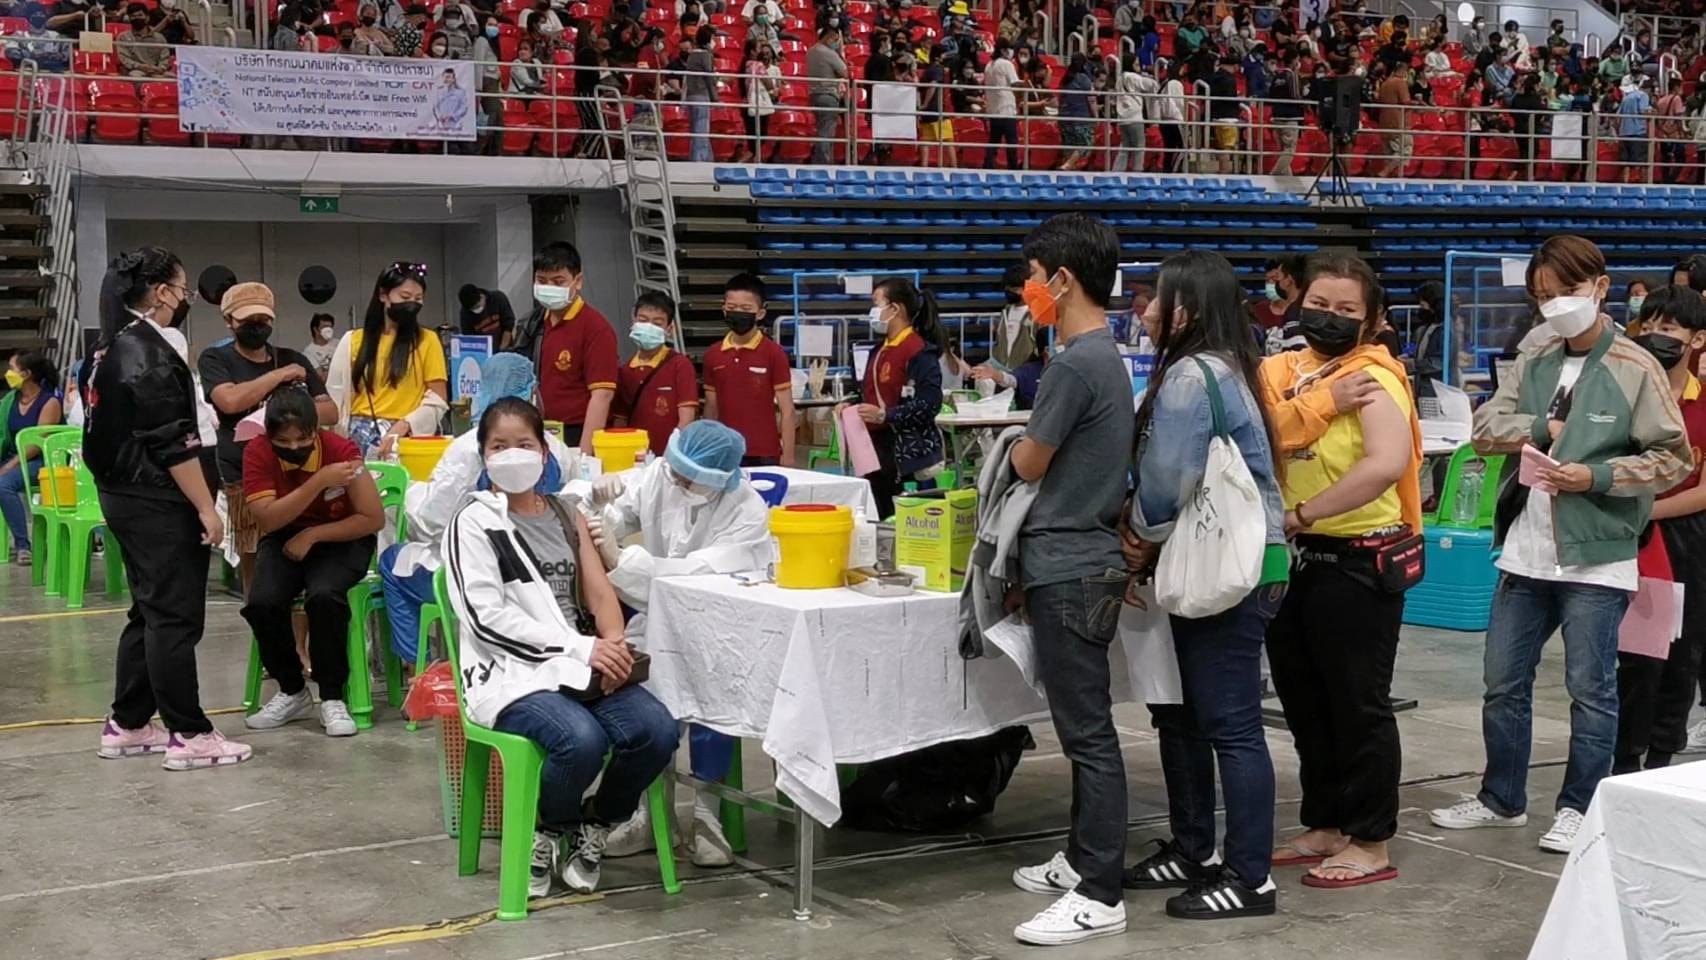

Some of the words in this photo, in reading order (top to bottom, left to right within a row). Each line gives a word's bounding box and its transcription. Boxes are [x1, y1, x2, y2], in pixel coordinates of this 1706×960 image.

[412, 81, 434, 90] CAT
[242, 87, 255, 97] NT
[391, 93, 410, 103] Free
[906, 516, 939, 529] Alcohol
